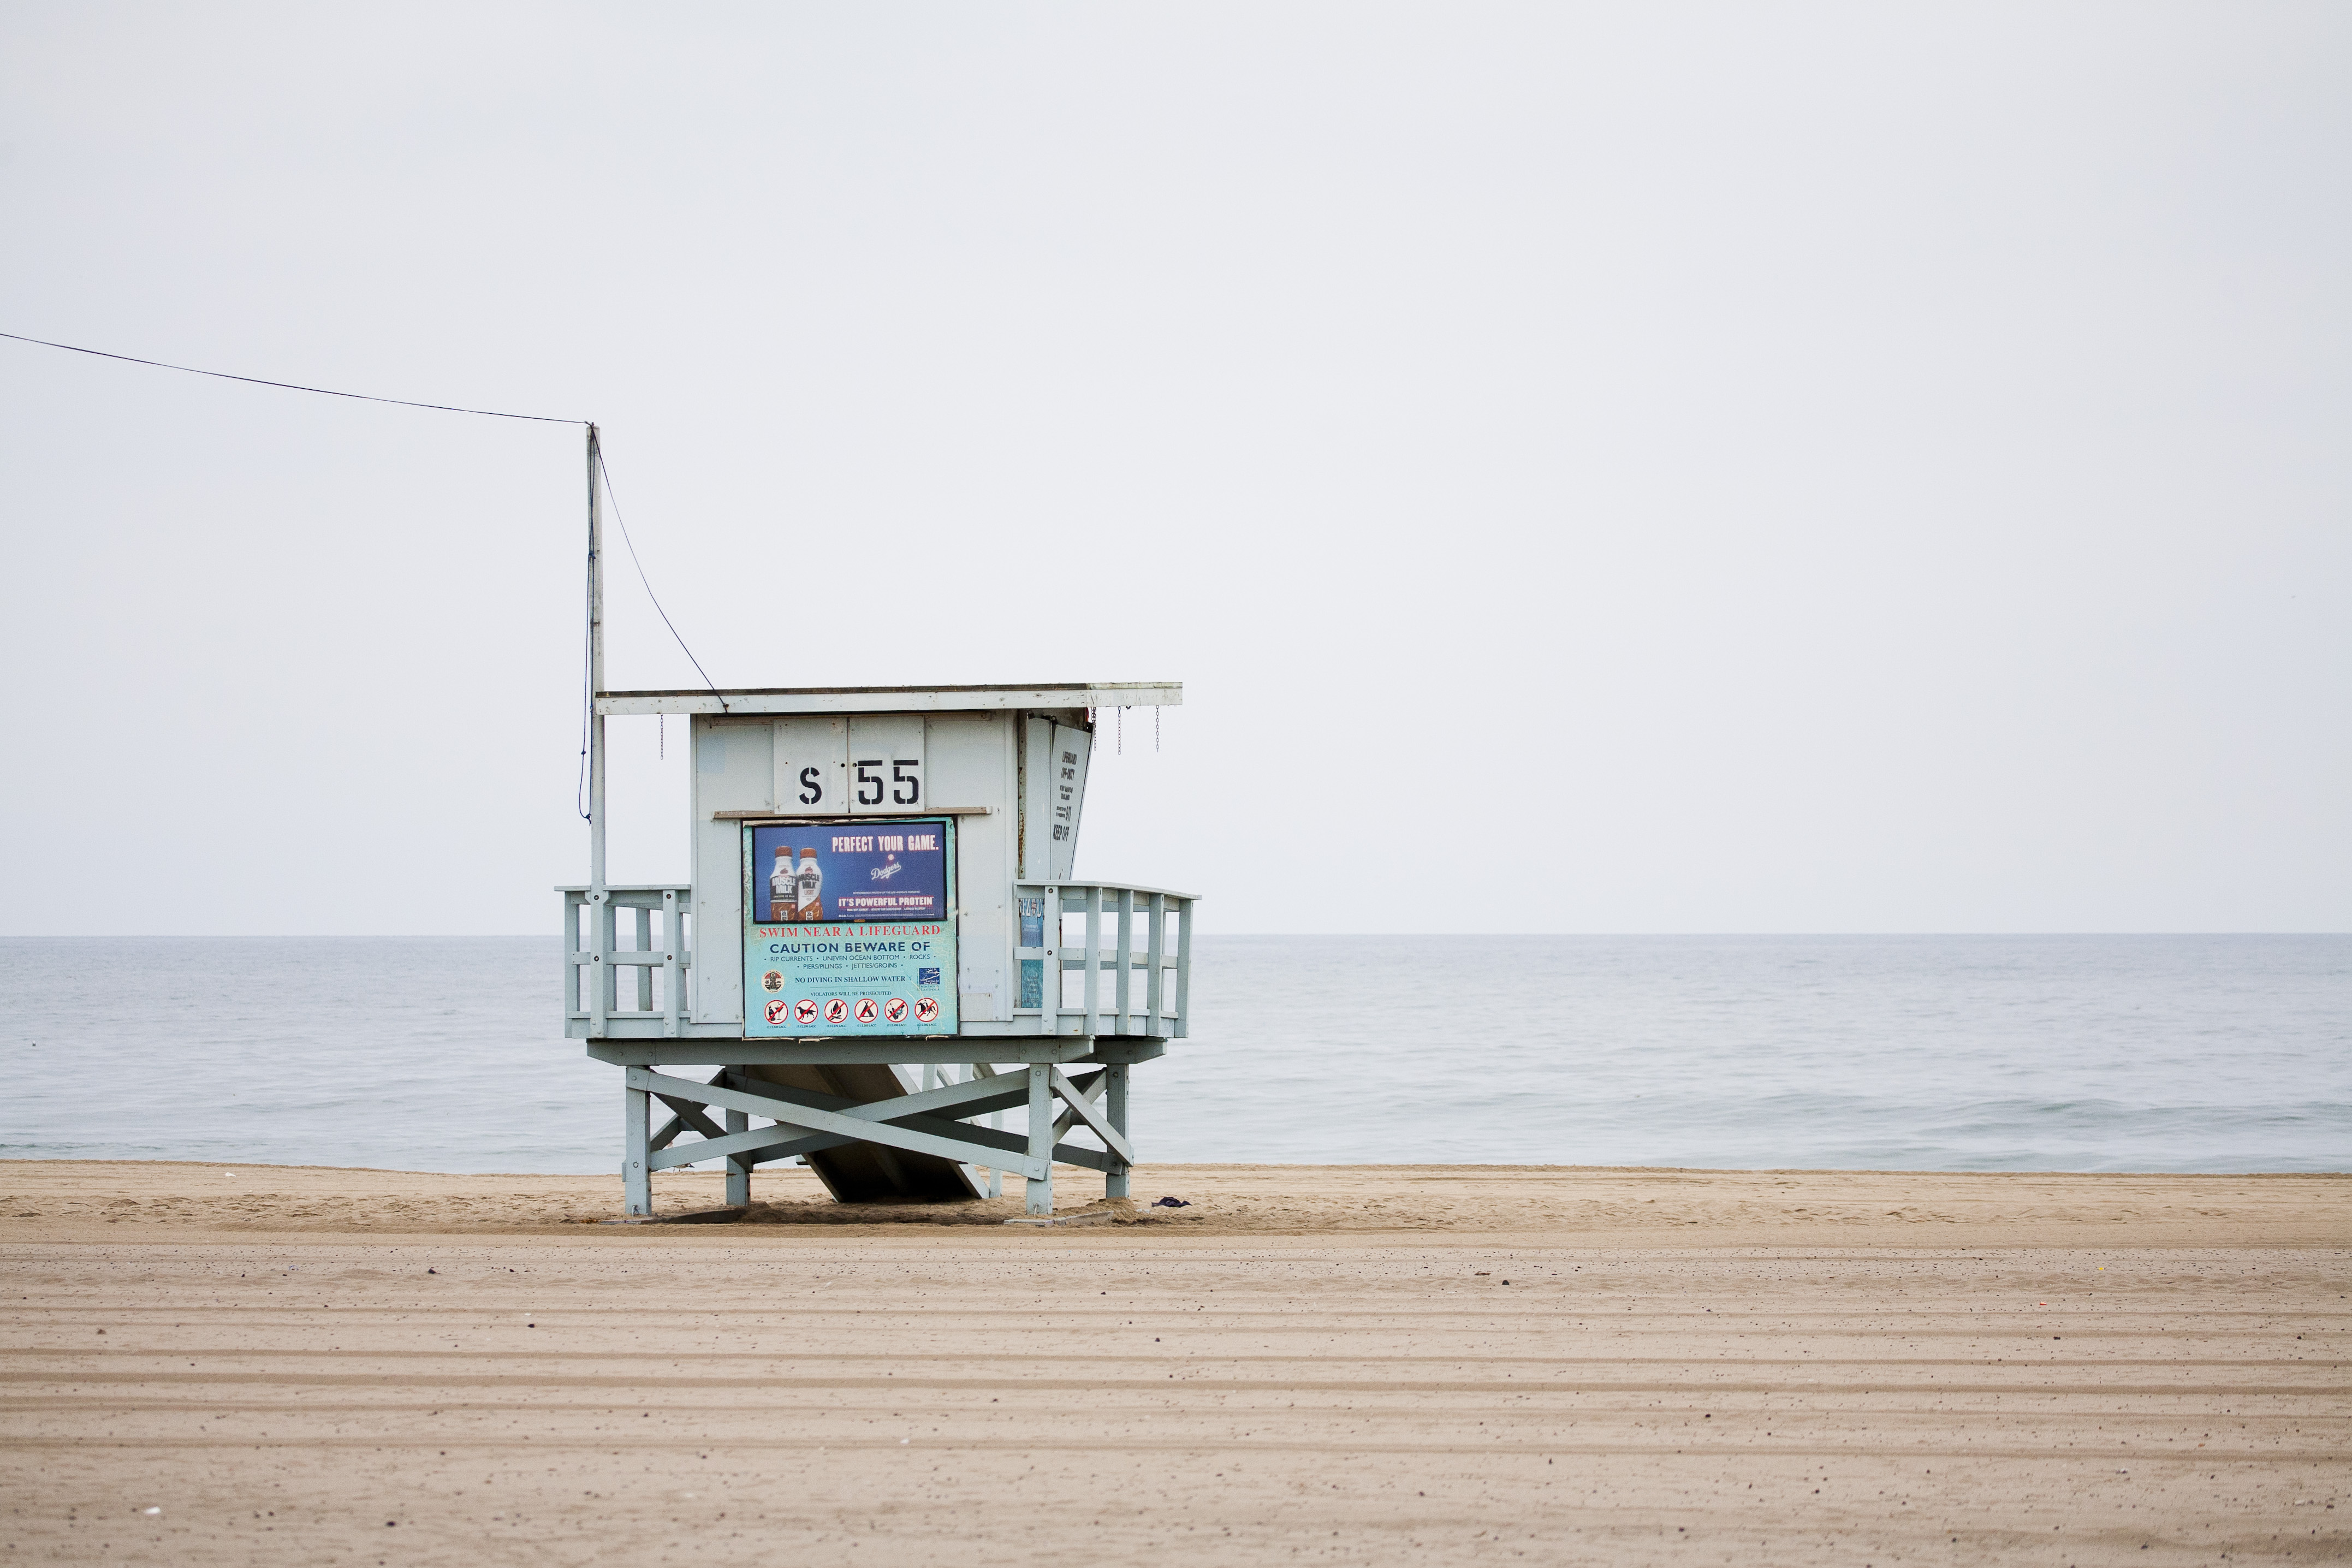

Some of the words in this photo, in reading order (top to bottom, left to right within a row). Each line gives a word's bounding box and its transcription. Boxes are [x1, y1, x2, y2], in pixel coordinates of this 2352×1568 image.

[799, 767, 822, 804] S
[858, 760, 919, 805] 55
[1053, 824, 1062, 840] KEEP
[832, 836, 873, 852] PERFECT
[878, 835, 904, 852] YOUR
[907, 834, 939, 851] GAME.
[871, 862, 902, 880] Dodgers
[773, 877, 796, 886] MUSCLE
[802, 880, 817, 889] MILK
[776, 885, 793, 894] MILK
[839, 898, 854, 906] IT'S
[856, 898, 898, 906] POWERFUL
[759, 927, 798, 938] SWIM
[803, 926, 841, 937] NEAR
[845, 926, 854, 936] A
[859, 925, 941, 936] LIFEGUARD
[770, 943, 839, 954] CAUTION
[845, 942, 905, 953] BEWARE
[911, 941, 930, 952] OF
